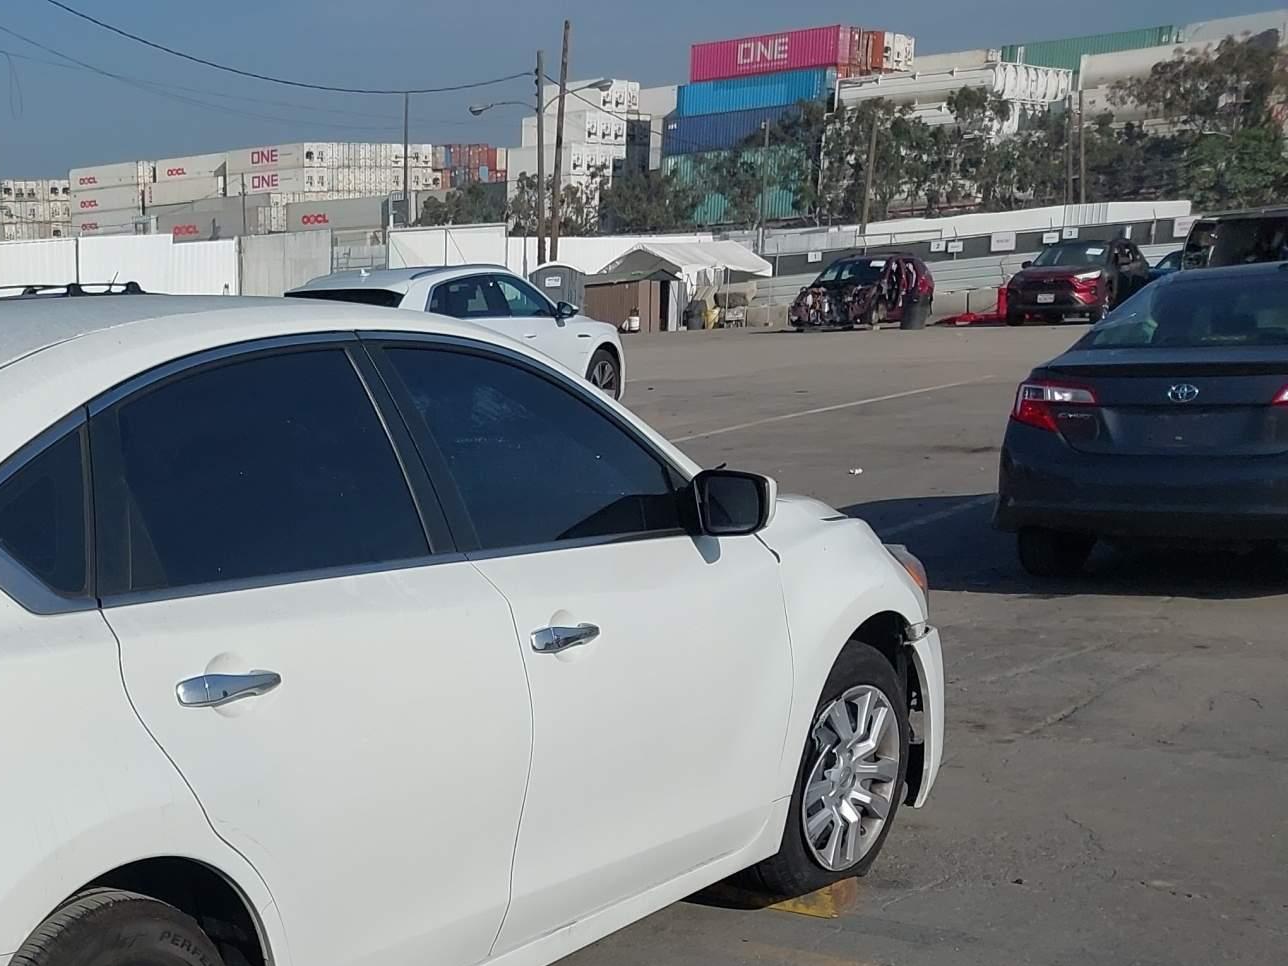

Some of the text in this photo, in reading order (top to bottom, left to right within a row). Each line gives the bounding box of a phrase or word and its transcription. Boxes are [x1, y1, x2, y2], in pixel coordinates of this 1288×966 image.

[737, 37, 789, 65] ONE
[251, 149, 279, 165] ONE
[167, 168, 187, 177] OOCL
[252, 174, 279, 189] ONE
[301, 214, 329, 225] OOCL
[173, 224, 200, 236] OOCL
